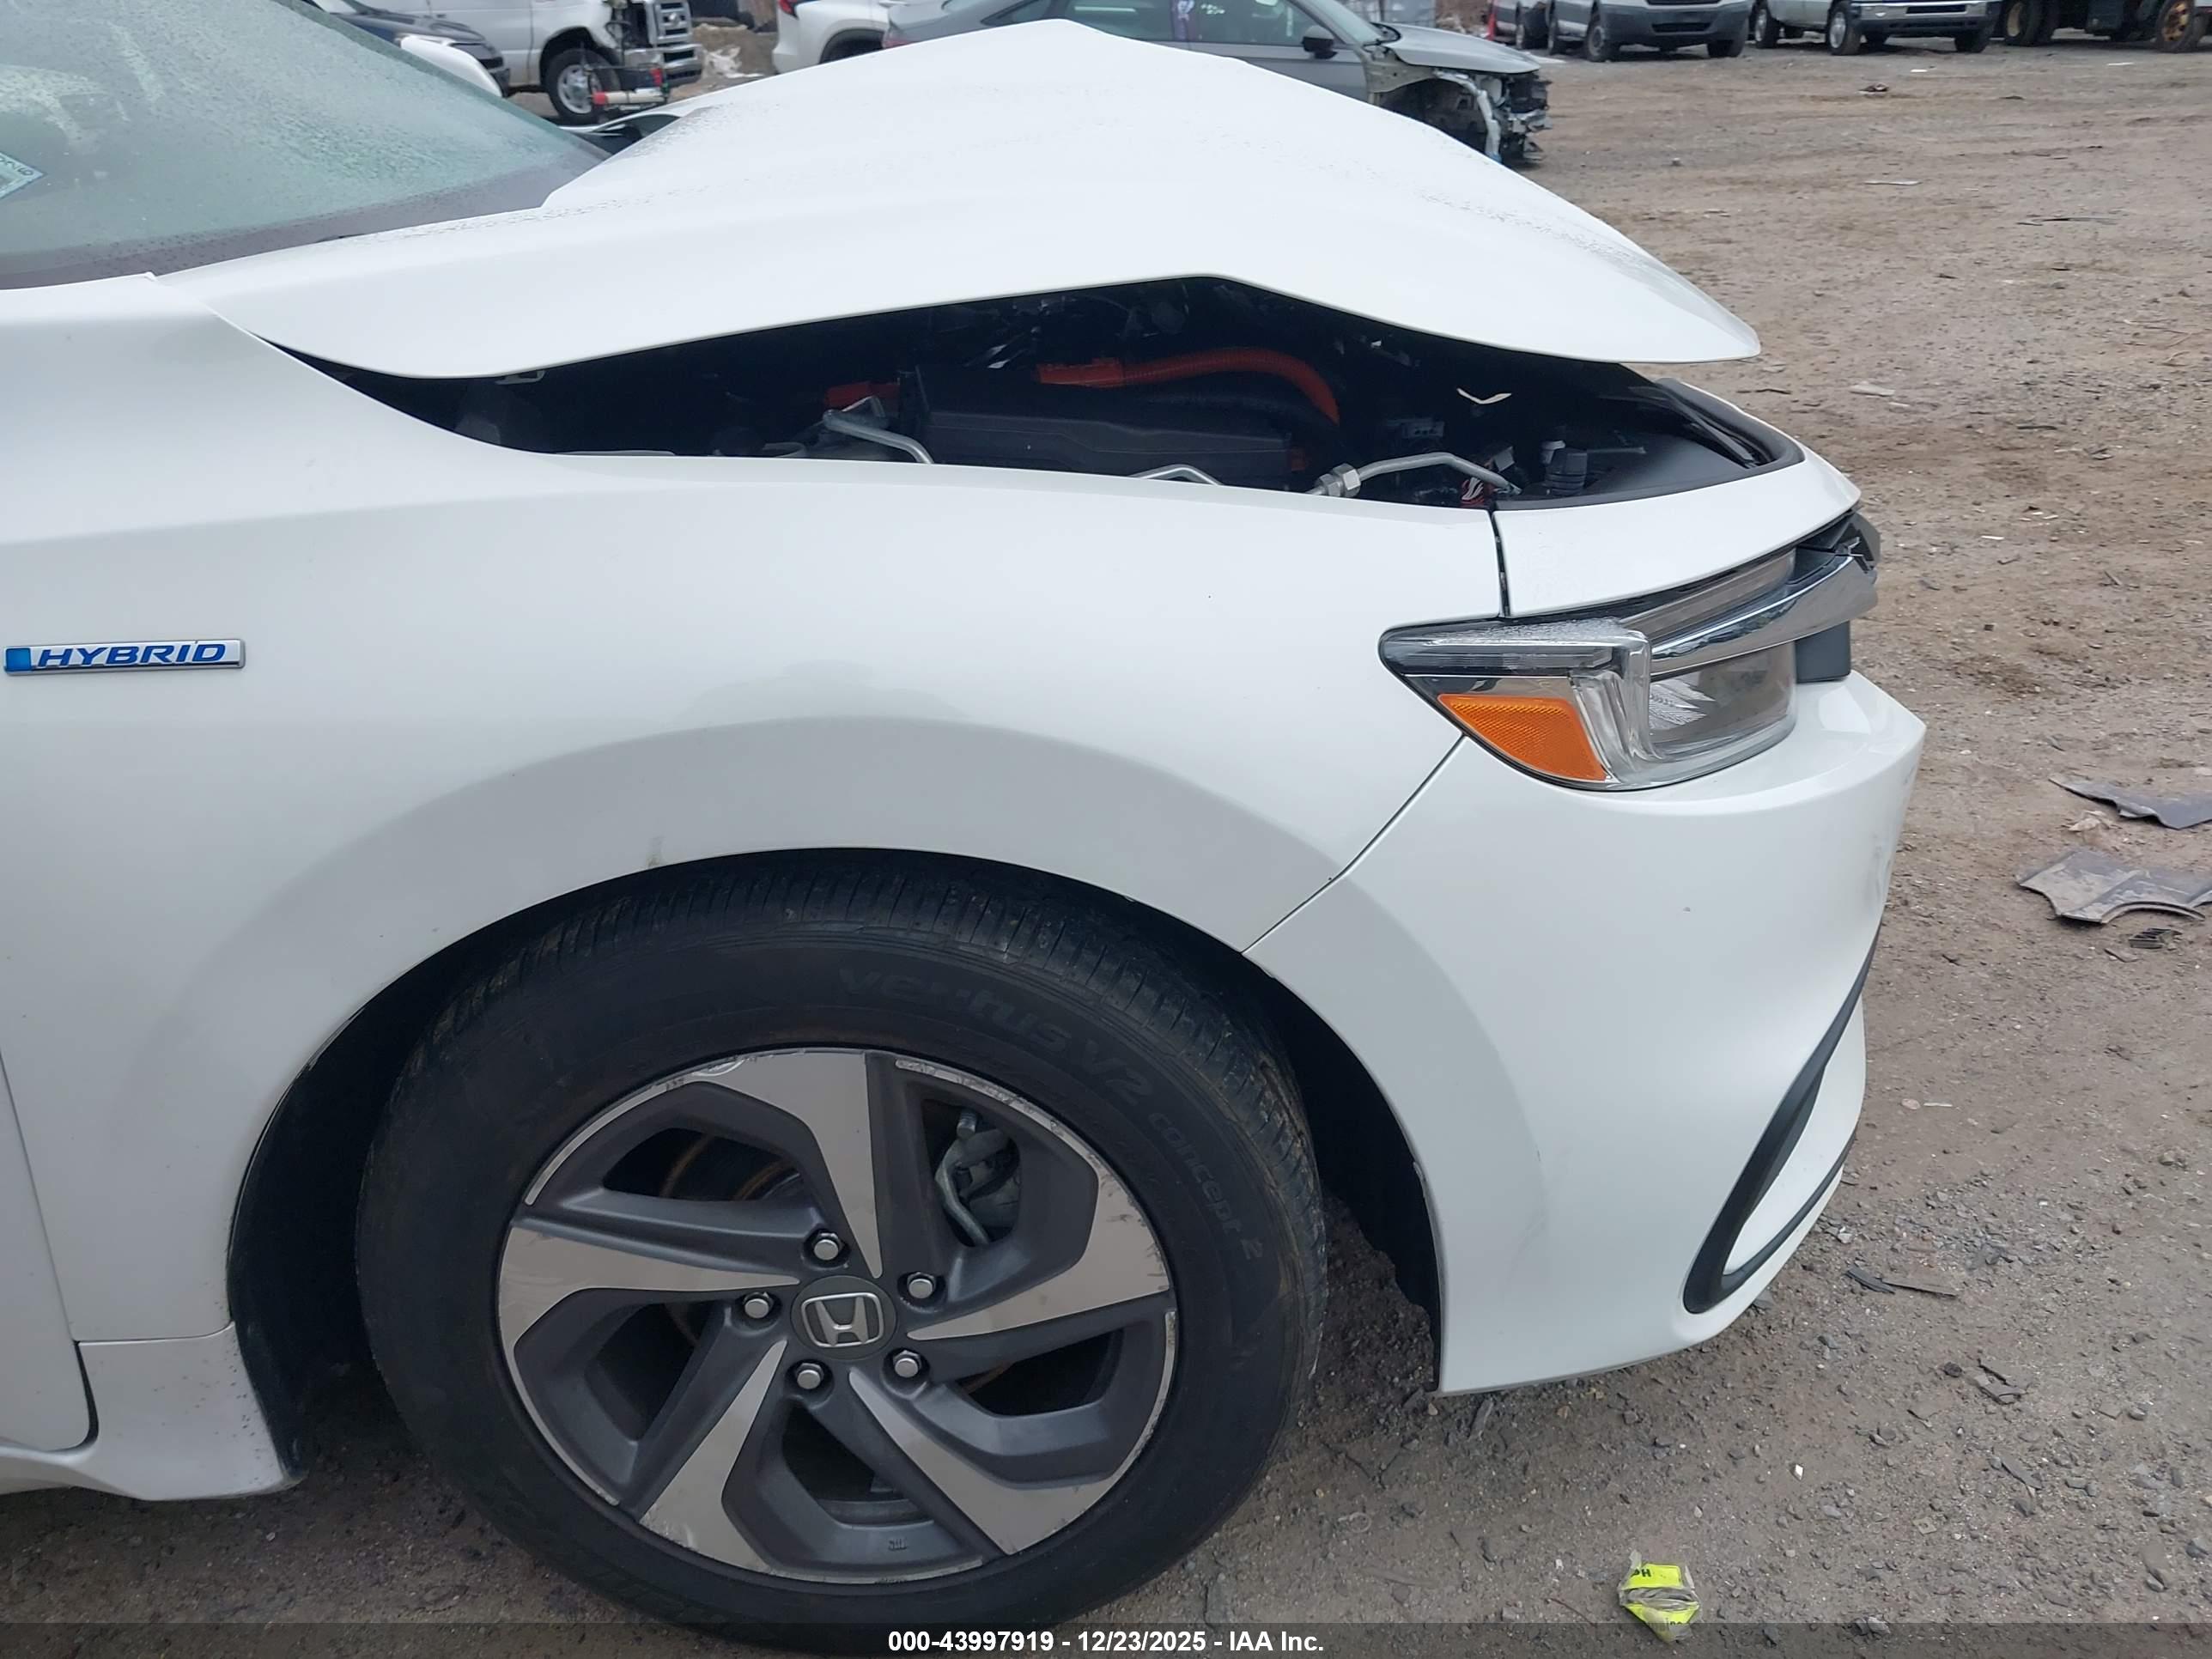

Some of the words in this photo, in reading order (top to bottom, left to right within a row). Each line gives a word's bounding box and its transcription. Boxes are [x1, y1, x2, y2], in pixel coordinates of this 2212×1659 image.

[37, 643, 227, 668] HYBRID
[1079, 1041, 1155, 1107] V2
[1148, 1109, 1242, 1234] concept
